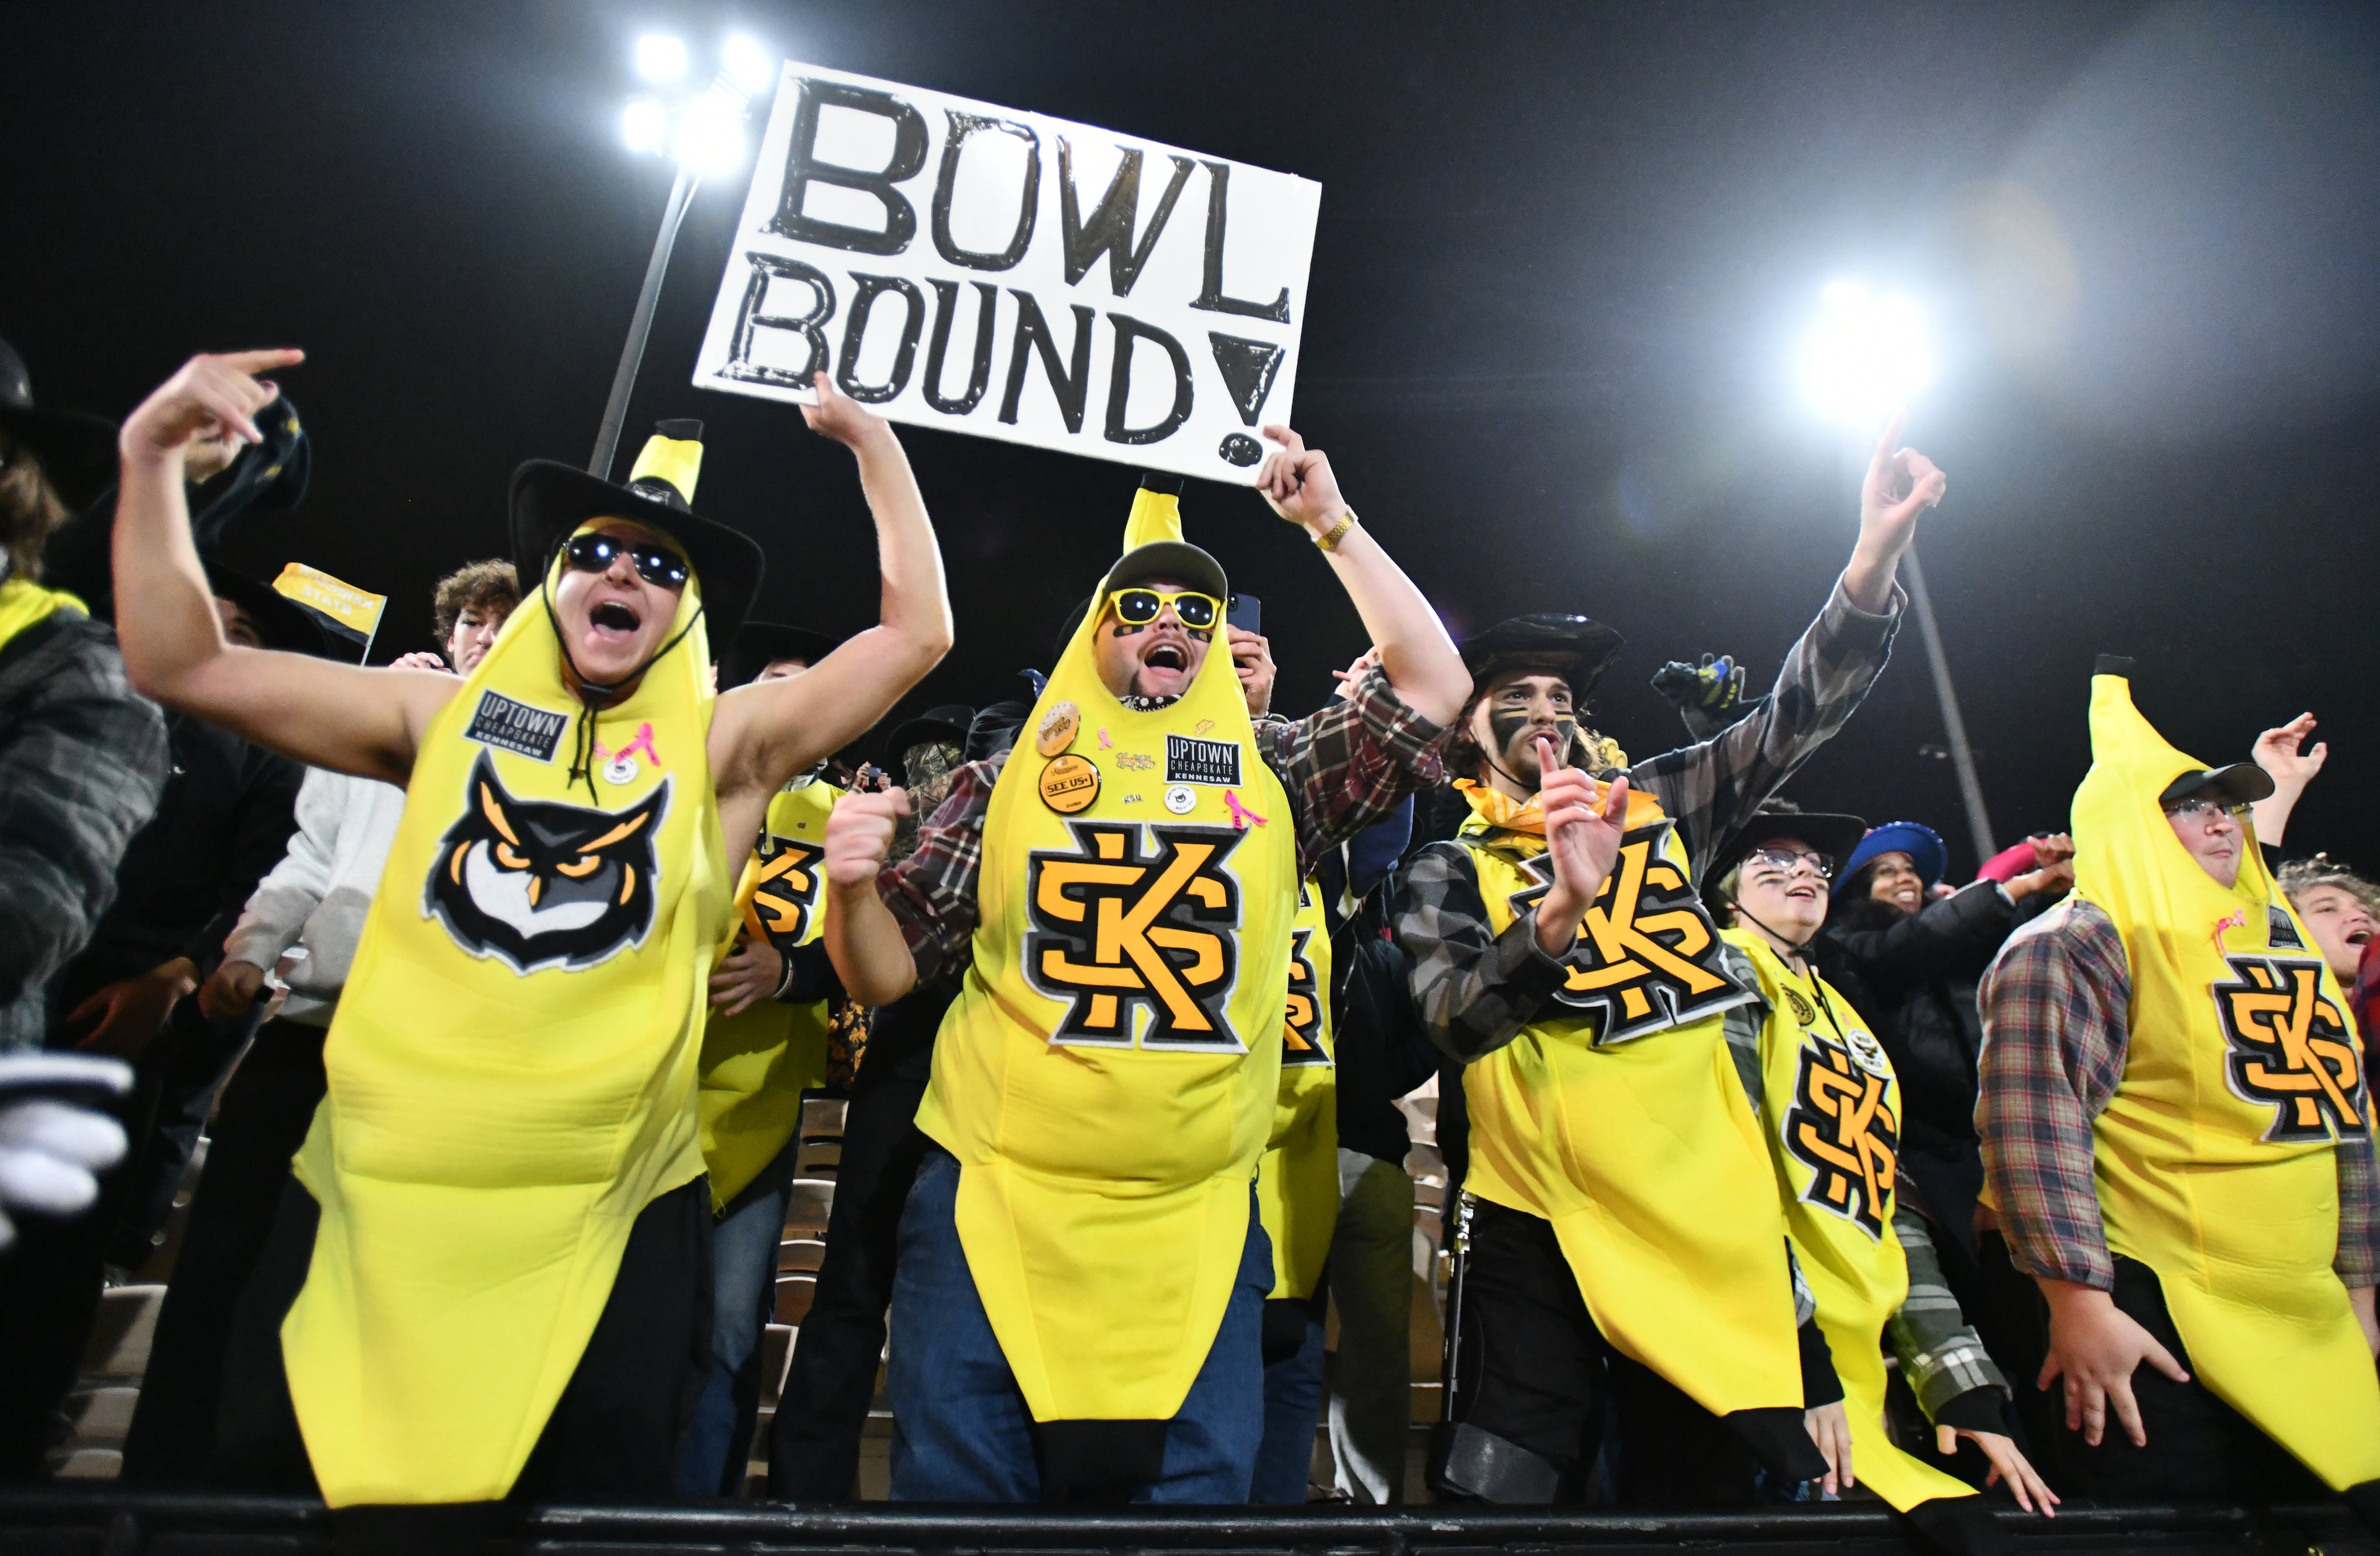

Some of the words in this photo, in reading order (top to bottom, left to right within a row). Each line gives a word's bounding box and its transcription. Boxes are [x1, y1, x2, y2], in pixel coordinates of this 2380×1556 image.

[759, 77, 1290, 324] BOWL
[713, 252, 1285, 466] BOUND!
[480, 694, 561, 736] UPTOWN
[475, 716, 552, 748] CHEAPSKATE
[475, 732, 543, 756] KENNESAW
[1170, 738, 1233, 765] UPTOWN
[1171, 760, 1233, 775] CHEAPSKATE
[1175, 773, 1231, 783] KENNESAW
[1047, 781, 1069, 793] SEE
